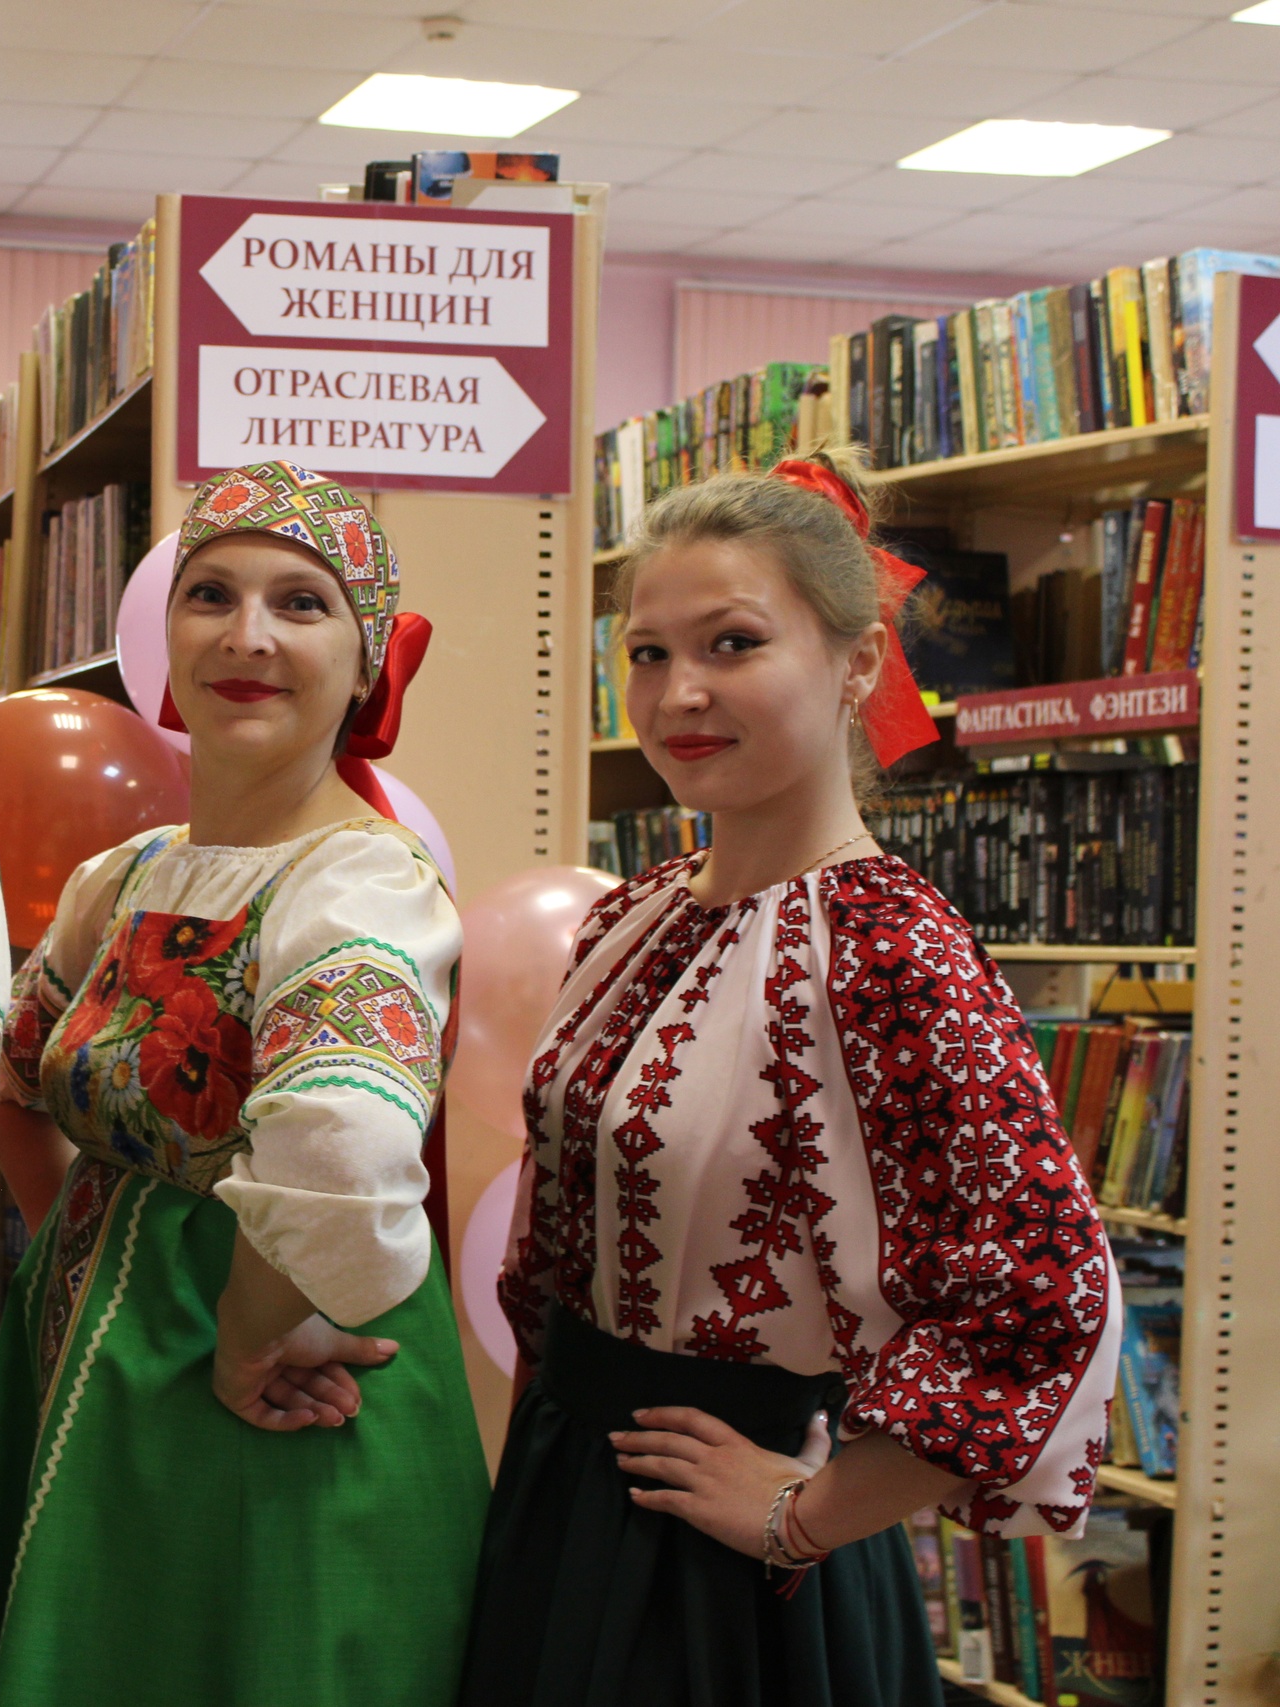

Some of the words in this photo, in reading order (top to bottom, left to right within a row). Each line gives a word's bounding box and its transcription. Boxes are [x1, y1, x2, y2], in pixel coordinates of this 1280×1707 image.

[242, 237, 439, 276] РОМАНЫ
[449, 247, 536, 285] ДЛЯ
[280, 286, 493, 330] ЖЕНЩИН
[233, 366, 481, 404] ОТРАСЛЕВАЯ
[240, 416, 485, 453] ЛИТЕРАТУРА
[956, 698, 1080, 734] ФАНТАСТИКА,
[1089, 685, 1188, 720] ФЭНТЕЗИ
